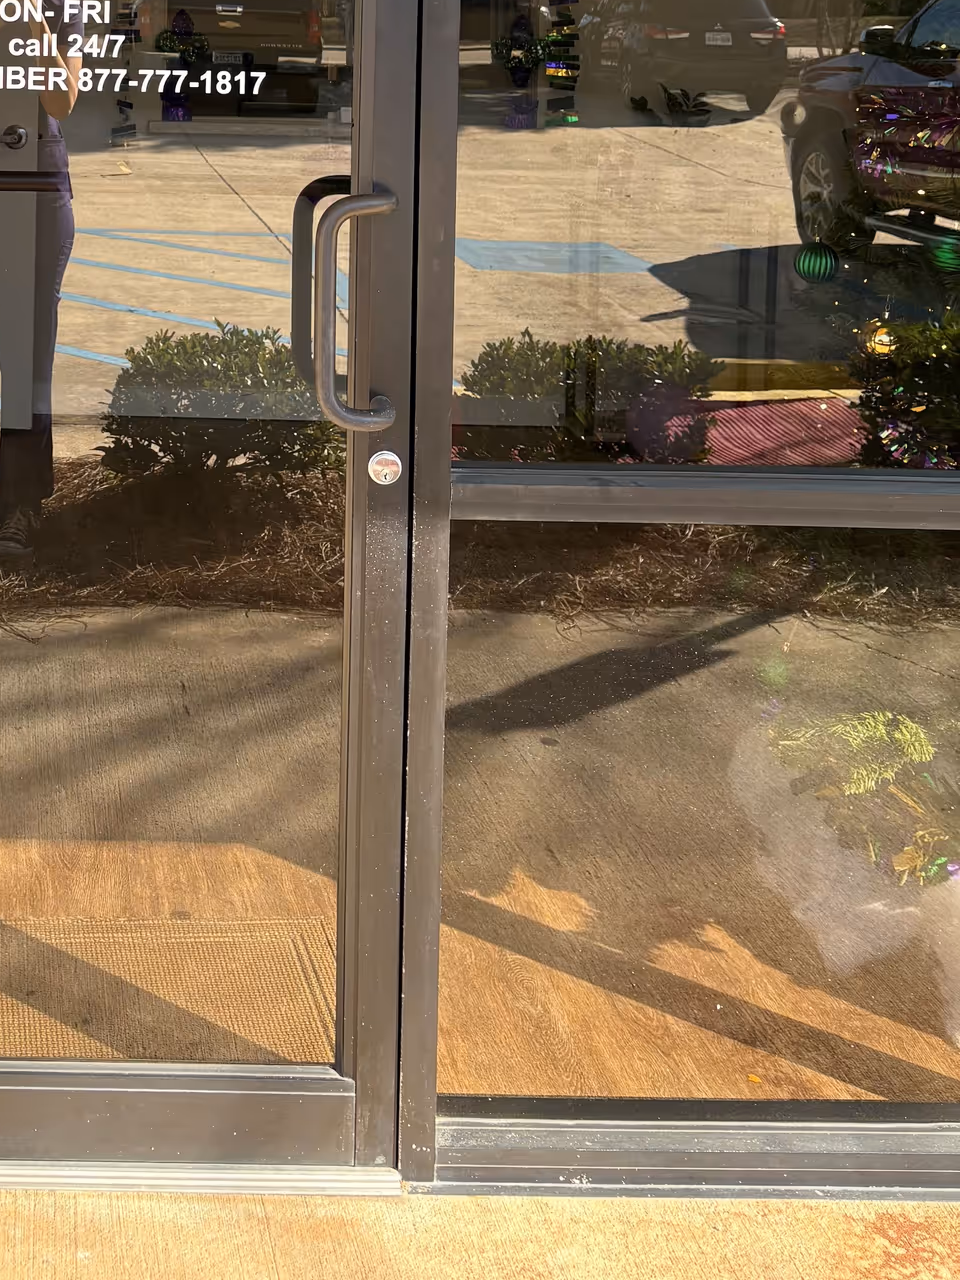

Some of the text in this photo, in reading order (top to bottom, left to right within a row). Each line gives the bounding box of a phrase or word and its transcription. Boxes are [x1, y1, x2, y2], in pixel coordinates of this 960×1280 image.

[63, 0, 110, 24] FRI
[8, 33, 58, 57] call
[66, 34, 126, 58] 24/7
[77, 67, 267, 95] 877-777-1817
